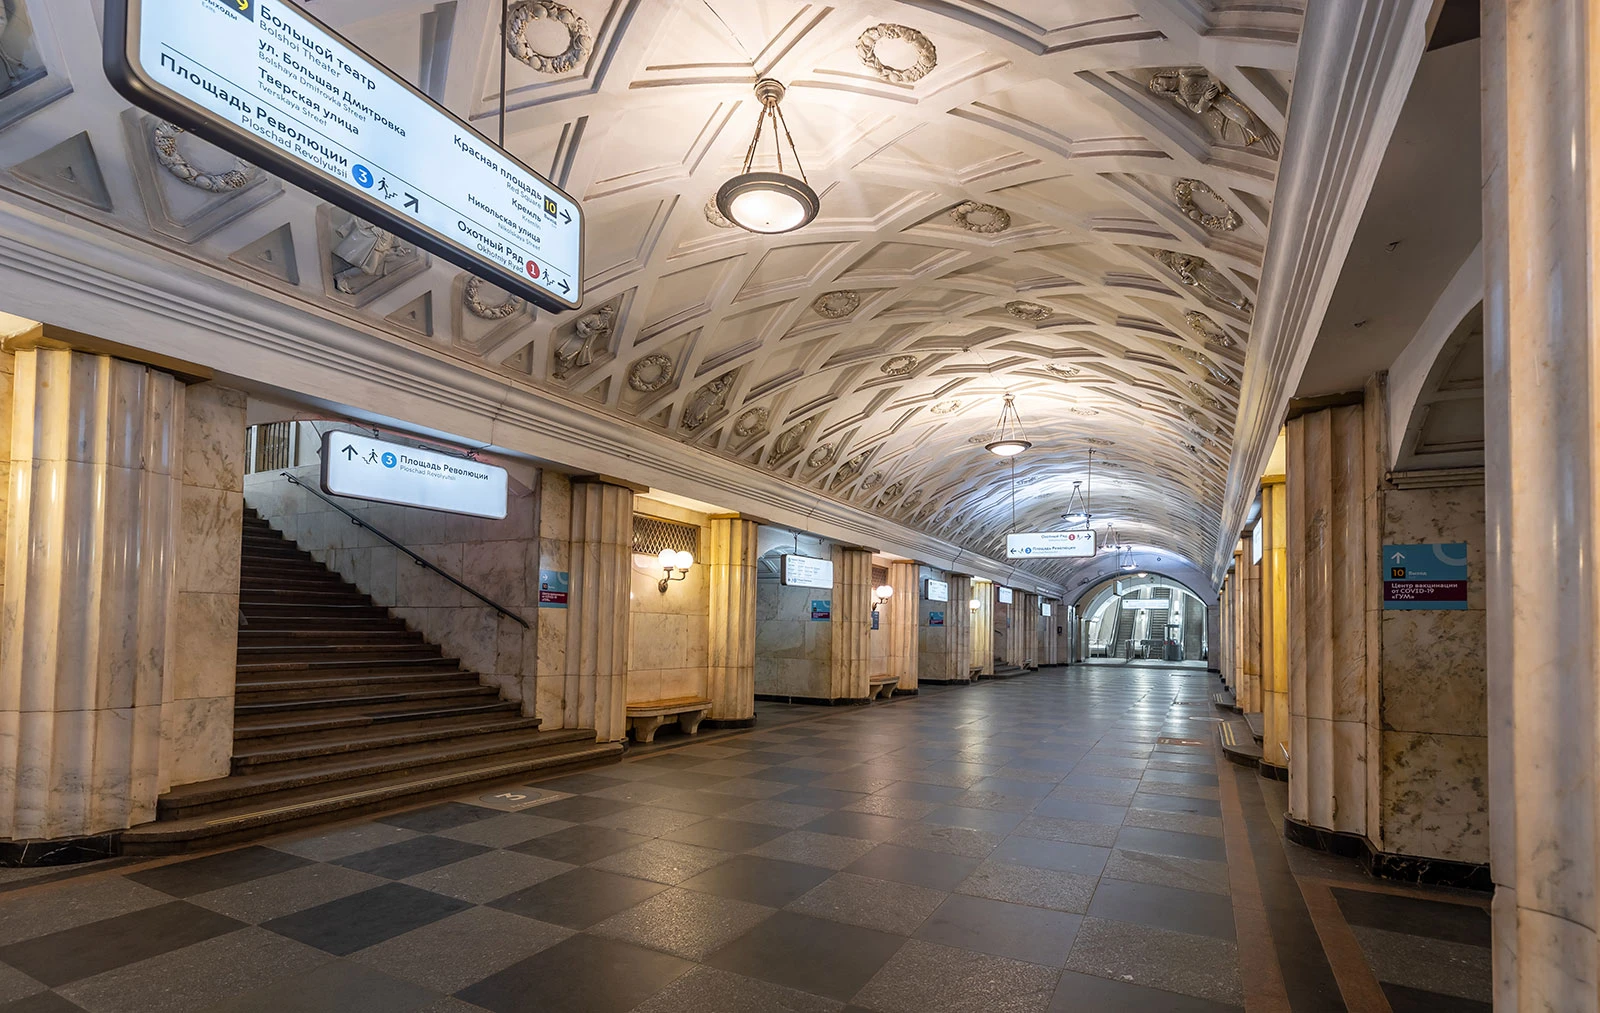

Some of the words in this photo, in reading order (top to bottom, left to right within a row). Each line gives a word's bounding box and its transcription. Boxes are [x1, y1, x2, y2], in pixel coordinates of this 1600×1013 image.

[205, 0, 238, 21] ыходы
[259, 20, 301, 52] Bolshoi
[302, 47, 341, 79] Theater
[260, 5, 333, 63] Большой
[336, 58, 377, 92] театр
[257, 81, 301, 112] Tverskaya
[301, 106, 328, 128] Street
[258, 51, 298, 81] Bolshaya
[299, 76, 342, 108] Dmitrovka
[343, 102, 367, 123] Street
[258, 39, 279, 58] ул.
[283, 52, 340, 96] Большая
[342, 91, 407, 138] Дмитровка
[258, 67, 321, 112] Тверская
[322, 107, 360, 136] улица
[160, 52, 252, 114] Площадь
[256, 106, 349, 168] Революции
[358, 169, 368, 184] 3
[241, 114, 292, 149] Ploschad
[295, 143, 349, 179] Revolyutsii
[453, 134, 498, 172] Красная
[500, 168, 543, 201] площадь
[544, 197, 557, 216] 10
[506, 181, 520, 196] Red
[467, 194, 517, 230] Никольская
[517, 225, 541, 244] улица
[511, 197, 542, 223] Кремль
[457, 220, 504, 253] Охотный
[505, 246, 524, 265] Ряд
[400, 455, 442, 472] Площадь
[443, 463, 489, 482] Революции
[1392, 569, 1405, 577] 10
